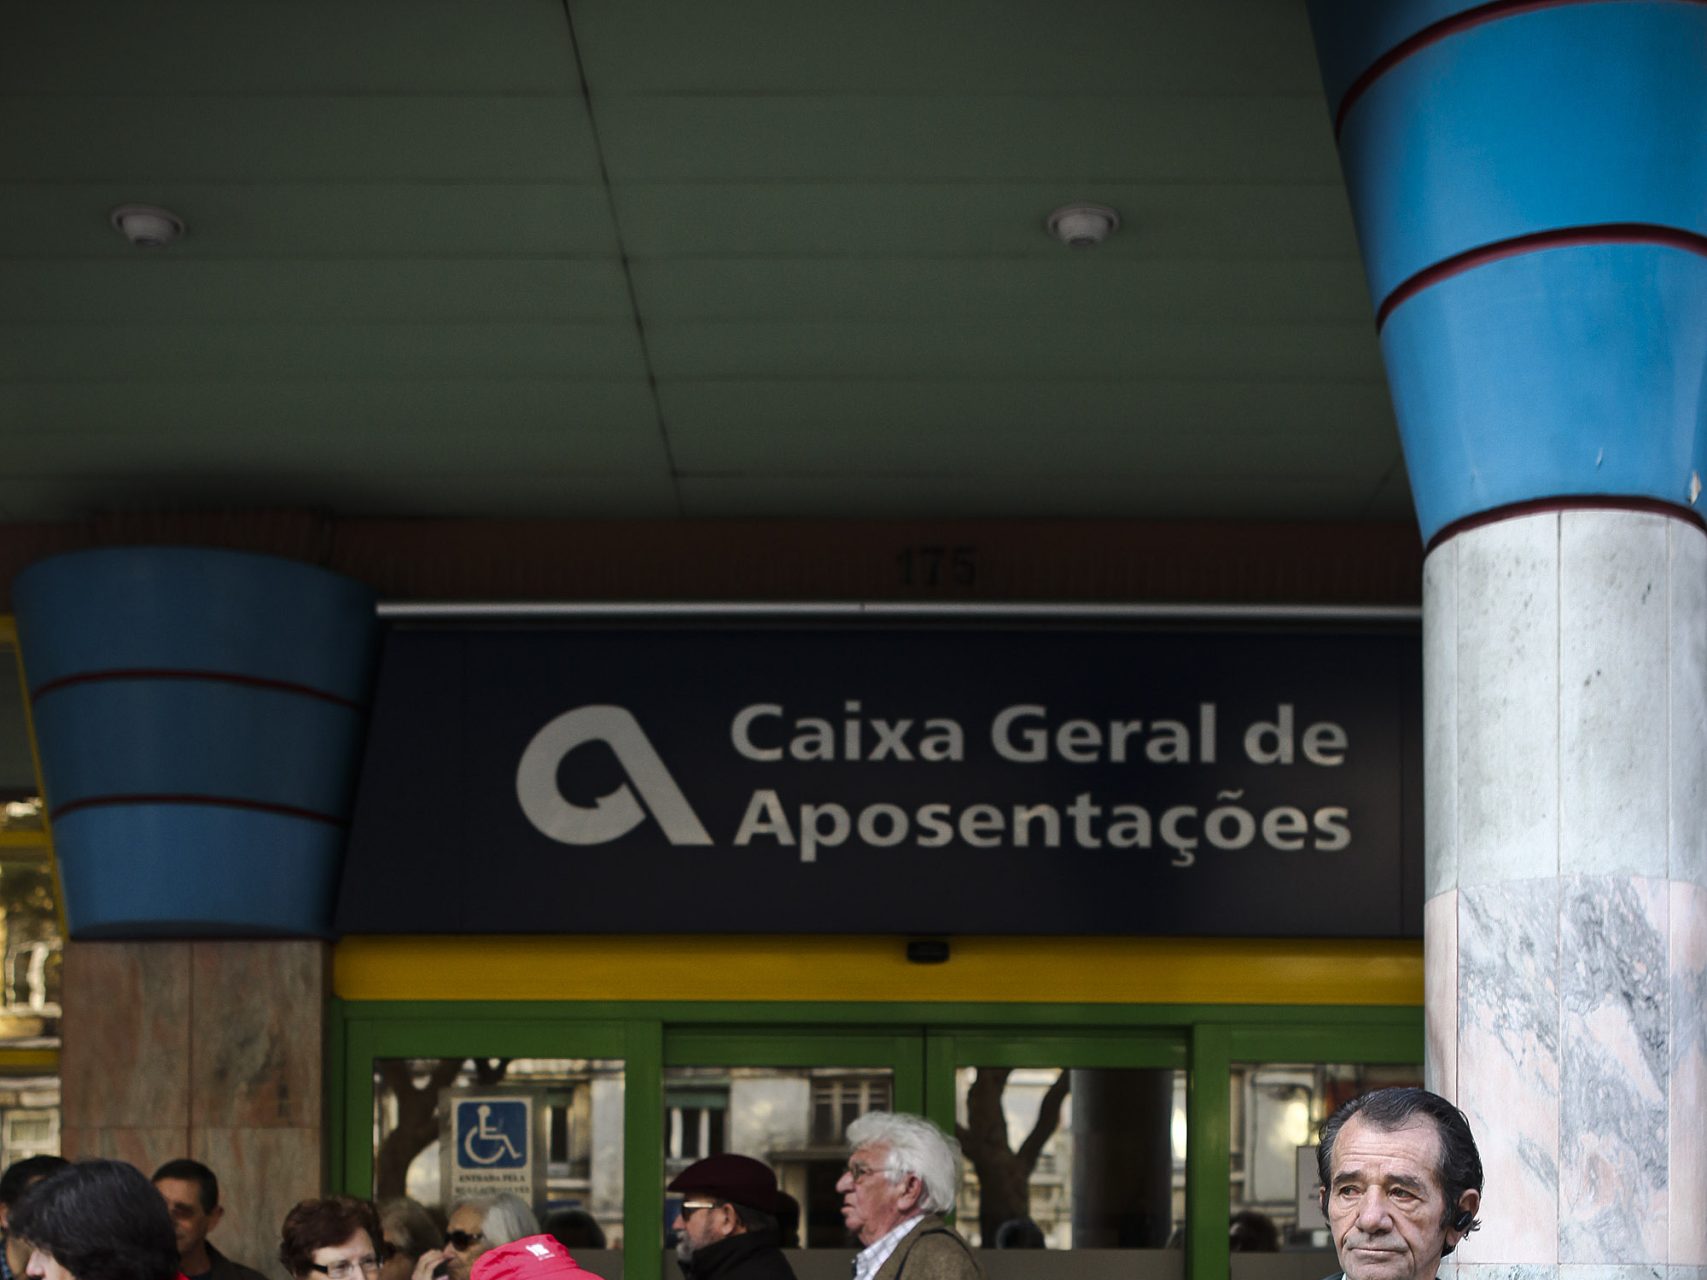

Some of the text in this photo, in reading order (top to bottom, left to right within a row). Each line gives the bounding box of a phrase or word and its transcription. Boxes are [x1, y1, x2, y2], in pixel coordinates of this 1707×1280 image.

[732, 701, 1348, 766] Caixa Geral de
[733, 788, 1352, 866] Aposentações
